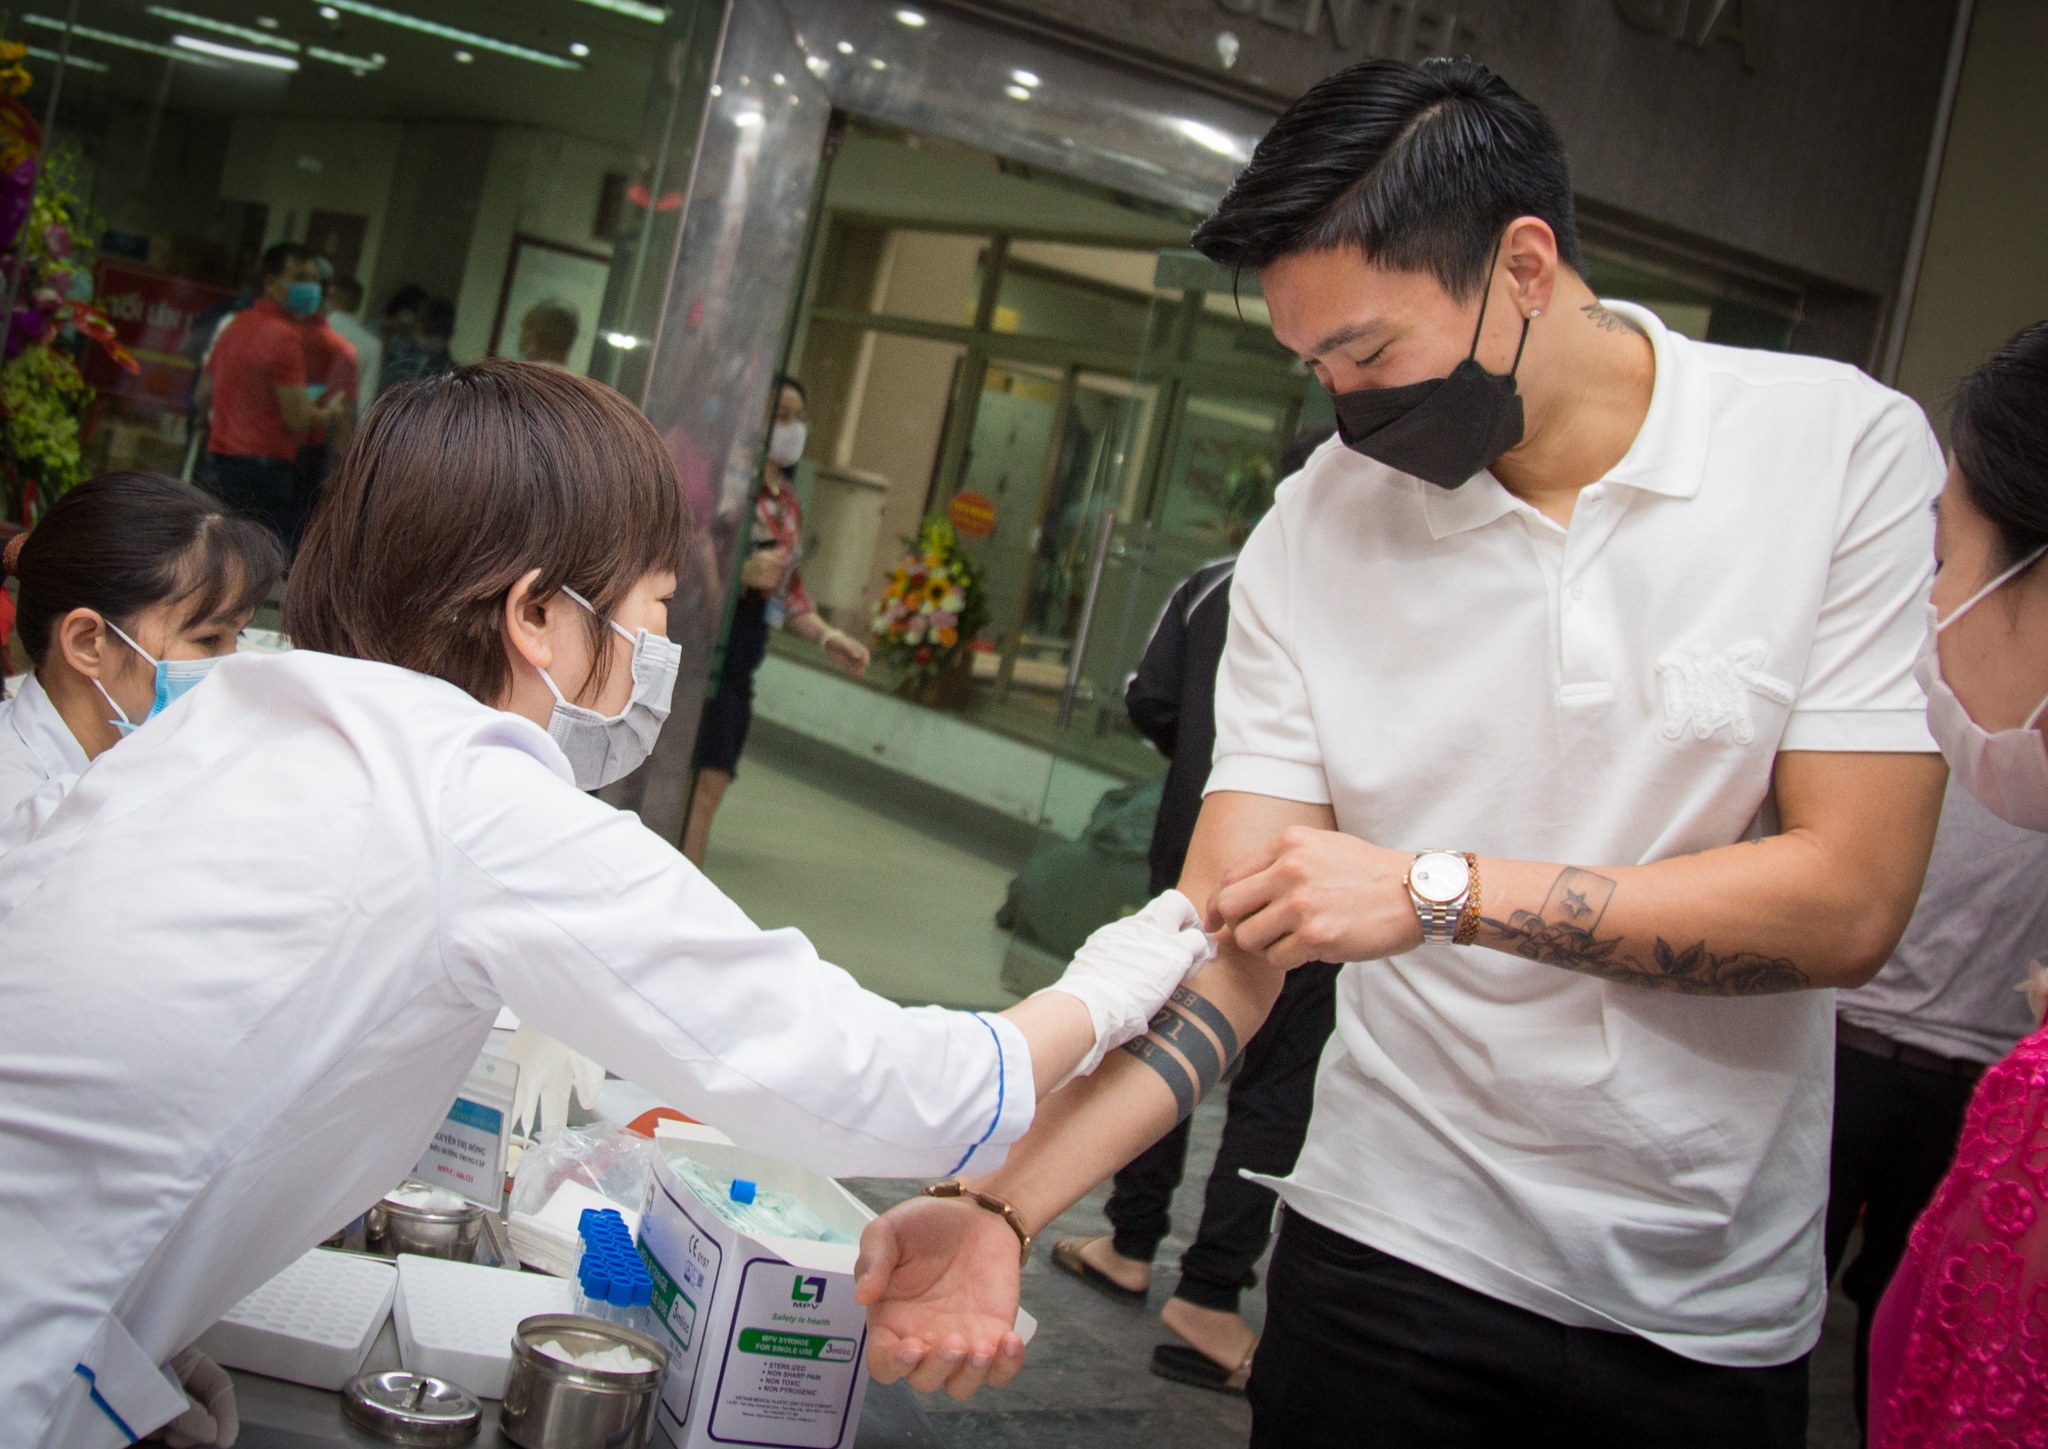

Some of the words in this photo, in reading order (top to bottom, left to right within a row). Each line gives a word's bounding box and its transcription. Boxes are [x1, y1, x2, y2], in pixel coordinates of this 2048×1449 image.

[1213, 0, 1478, 58] NTER
[792, 1301, 820, 1310] MPV
[772, 1312, 797, 1325] Safety
[806, 1317, 831, 1327] health
[761, 1334, 778, 1343] MPV
[778, 1336, 810, 1347] SYRINGE
[755, 1343, 770, 1352] FOR
[771, 1345, 798, 1355] SINGLE
[798, 1347, 814, 1356] USE
[768, 1362, 807, 1372] STERILIZED
[766, 1370, 782, 1378] NON
[782, 1371, 806, 1379] SHARP
[806, 1373, 822, 1381] PAIN
[764, 1378, 780, 1386] NON
[781, 1379, 801, 1387] TOXIC
[779, 1387, 818, 1397] PYROGENIC
